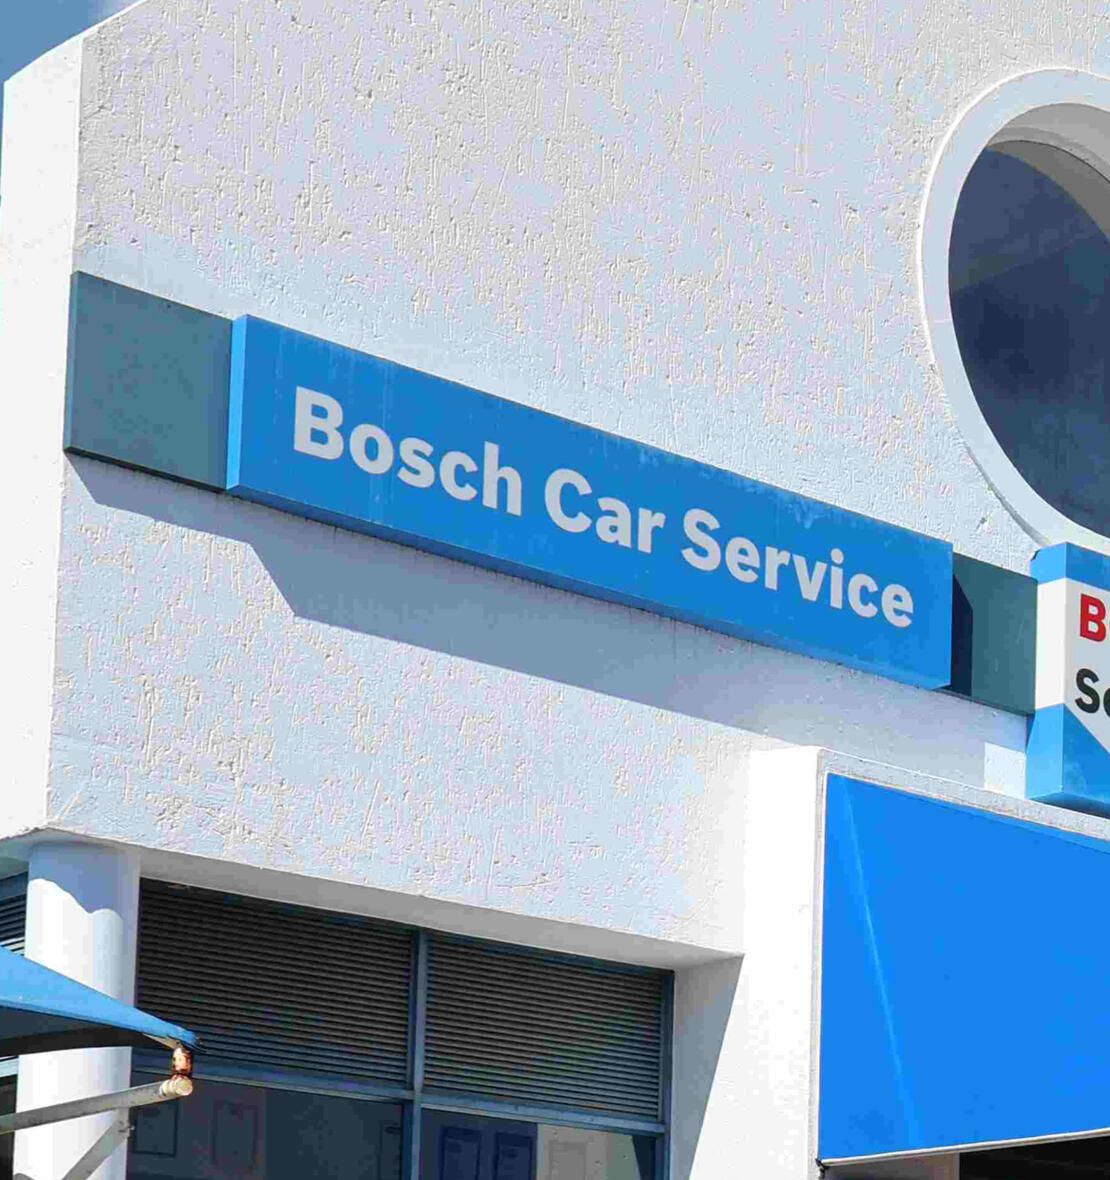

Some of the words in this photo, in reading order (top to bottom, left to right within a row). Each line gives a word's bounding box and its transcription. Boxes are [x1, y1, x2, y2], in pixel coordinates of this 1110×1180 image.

[293, 385, 522, 516] Bosch
[544, 468, 666, 554] Car
[681, 508, 915, 628] Service
